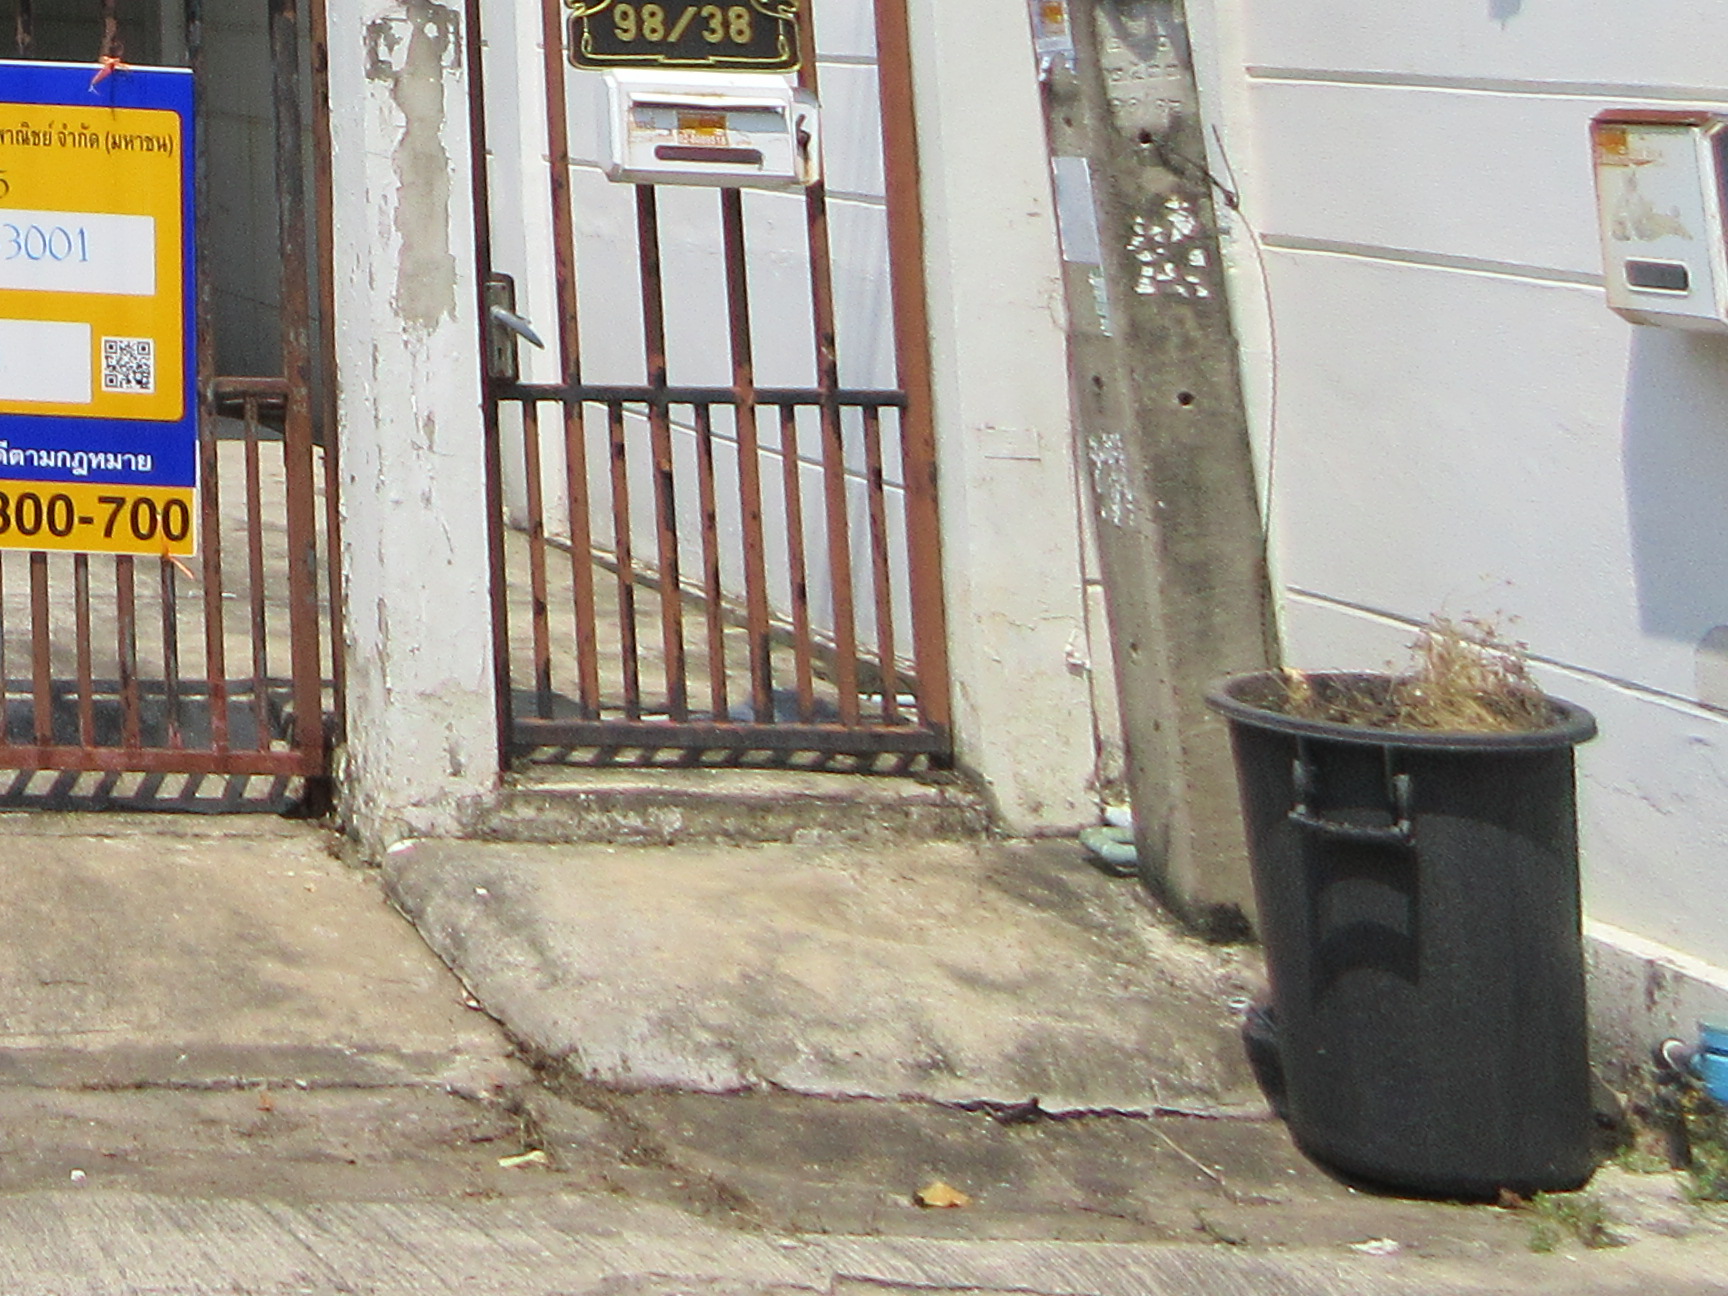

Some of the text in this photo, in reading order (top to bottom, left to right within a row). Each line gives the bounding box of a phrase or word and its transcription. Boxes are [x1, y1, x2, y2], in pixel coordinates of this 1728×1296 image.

[613, 3, 751, 43] 98/38
[58, 123, 100, 149] จำกัด
[105, 130, 174, 157] (มหาชน)
